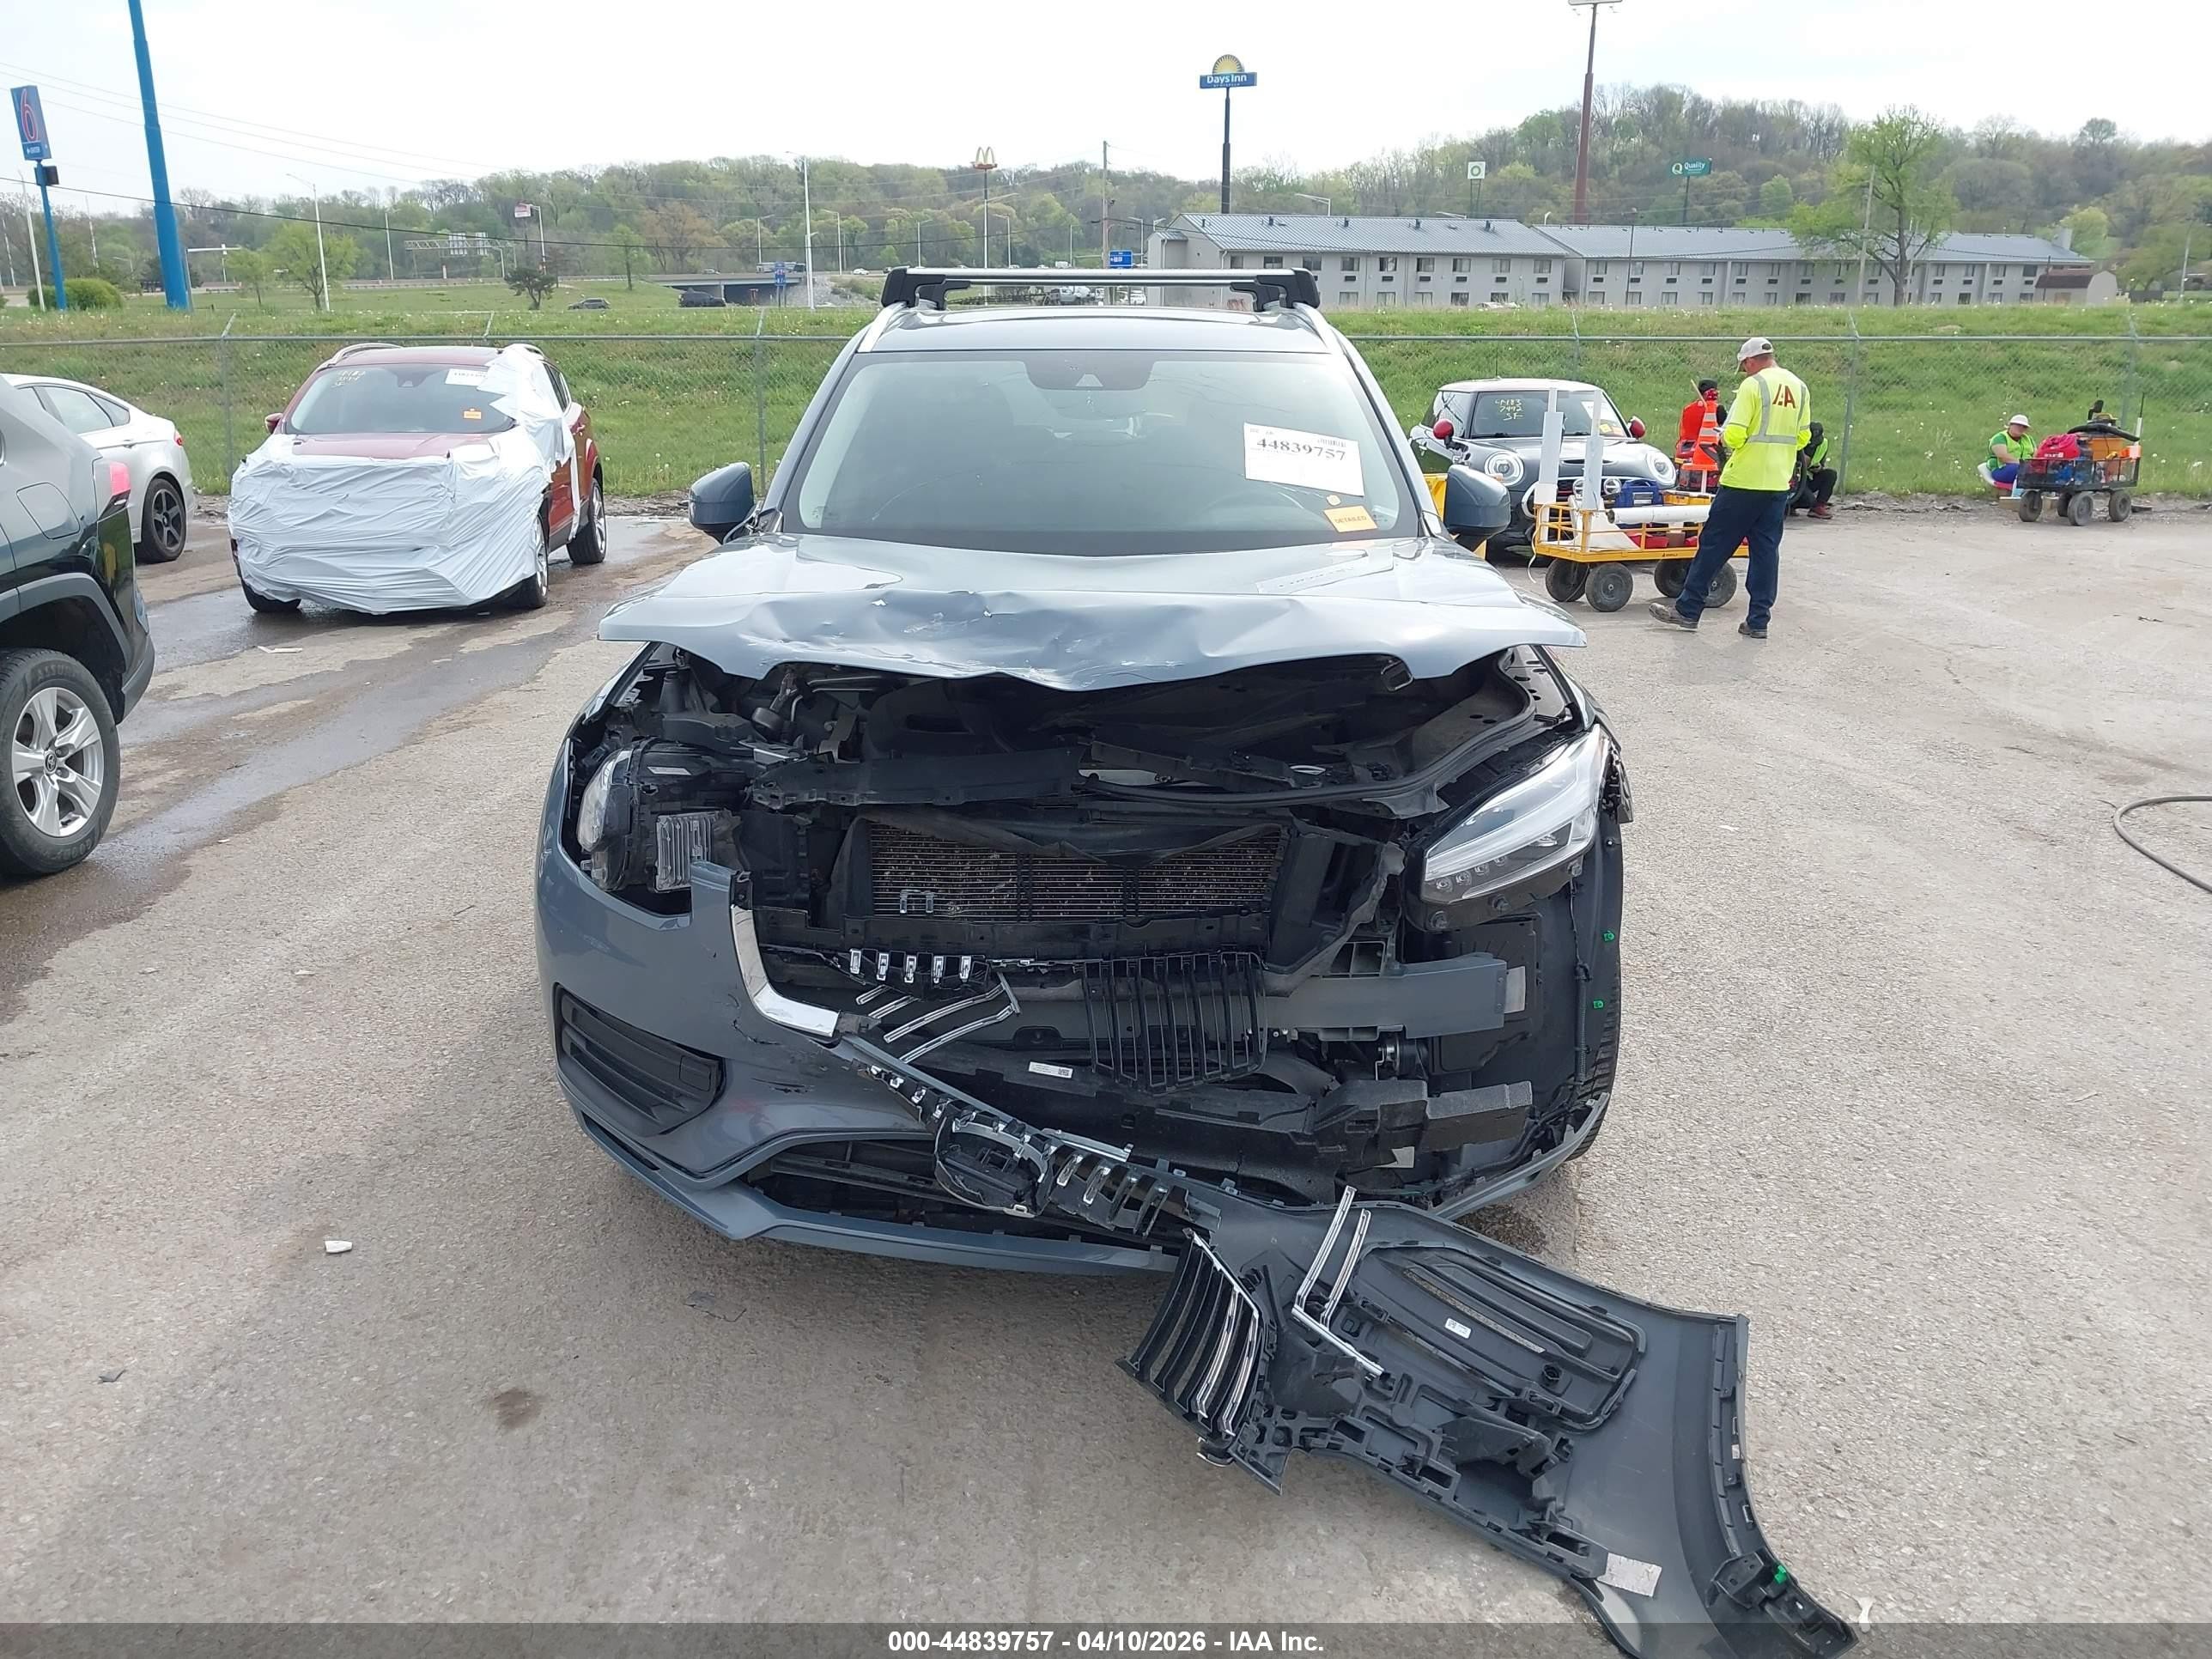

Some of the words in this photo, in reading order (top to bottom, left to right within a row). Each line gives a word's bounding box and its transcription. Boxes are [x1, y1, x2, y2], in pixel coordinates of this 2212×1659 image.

[1206, 75, 1231, 84] Days
[1231, 74, 1248, 83] Inn
[21, 88, 38, 143] 6
[1684, 161, 1705, 170] Quality
[1256, 437, 1346, 461] 44839757
